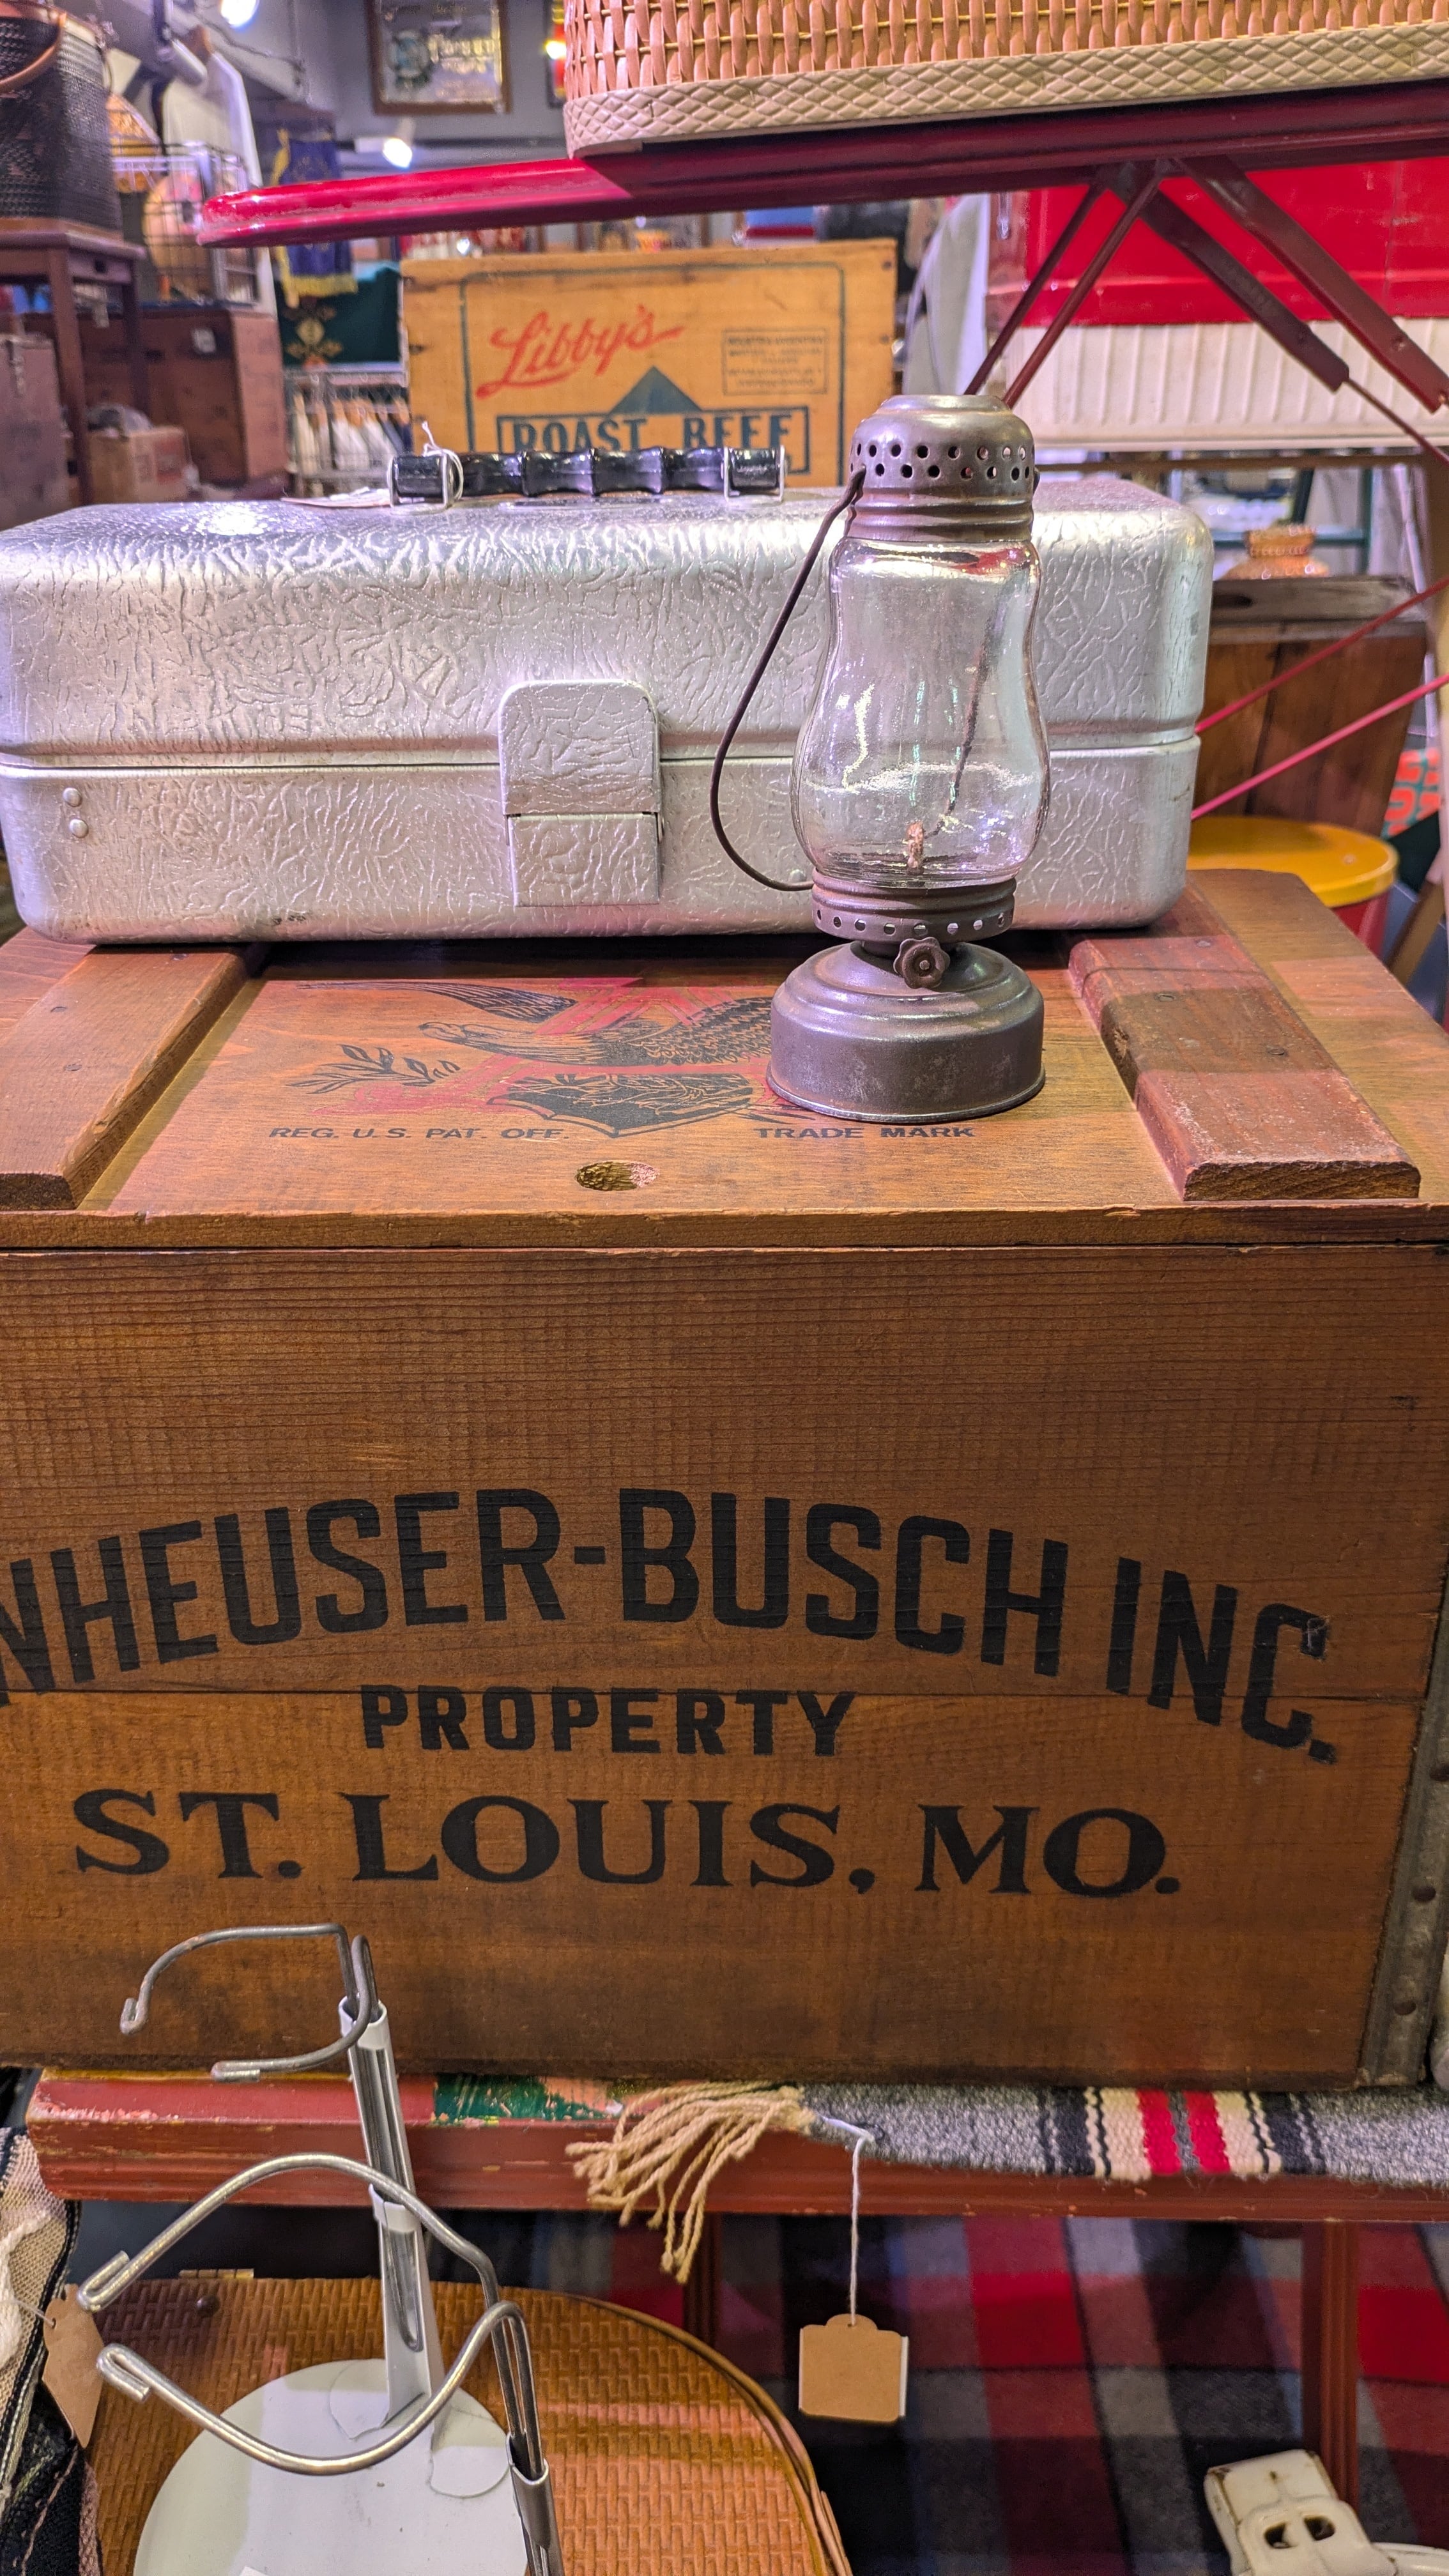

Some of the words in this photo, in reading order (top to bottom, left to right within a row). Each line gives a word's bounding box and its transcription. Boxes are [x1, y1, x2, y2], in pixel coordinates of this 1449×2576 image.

[475, 304, 686, 401] Libby's
[268, 1128, 339, 1138] REG.
[425, 1128, 487, 1139] PAT.
[500, 1128, 570, 1139] OFF.
[753, 1128, 863, 1138] TRADE
[880, 1127, 976, 1138] MARK
[1106, 1557, 1338, 1765] INC.
[360, 1684, 857, 1756] PROPERTY
[73, 1789, 302, 1880] ST.
[339, 1792, 876, 1895] LOUIS,
[914, 1804, 1180, 1898] MO.
